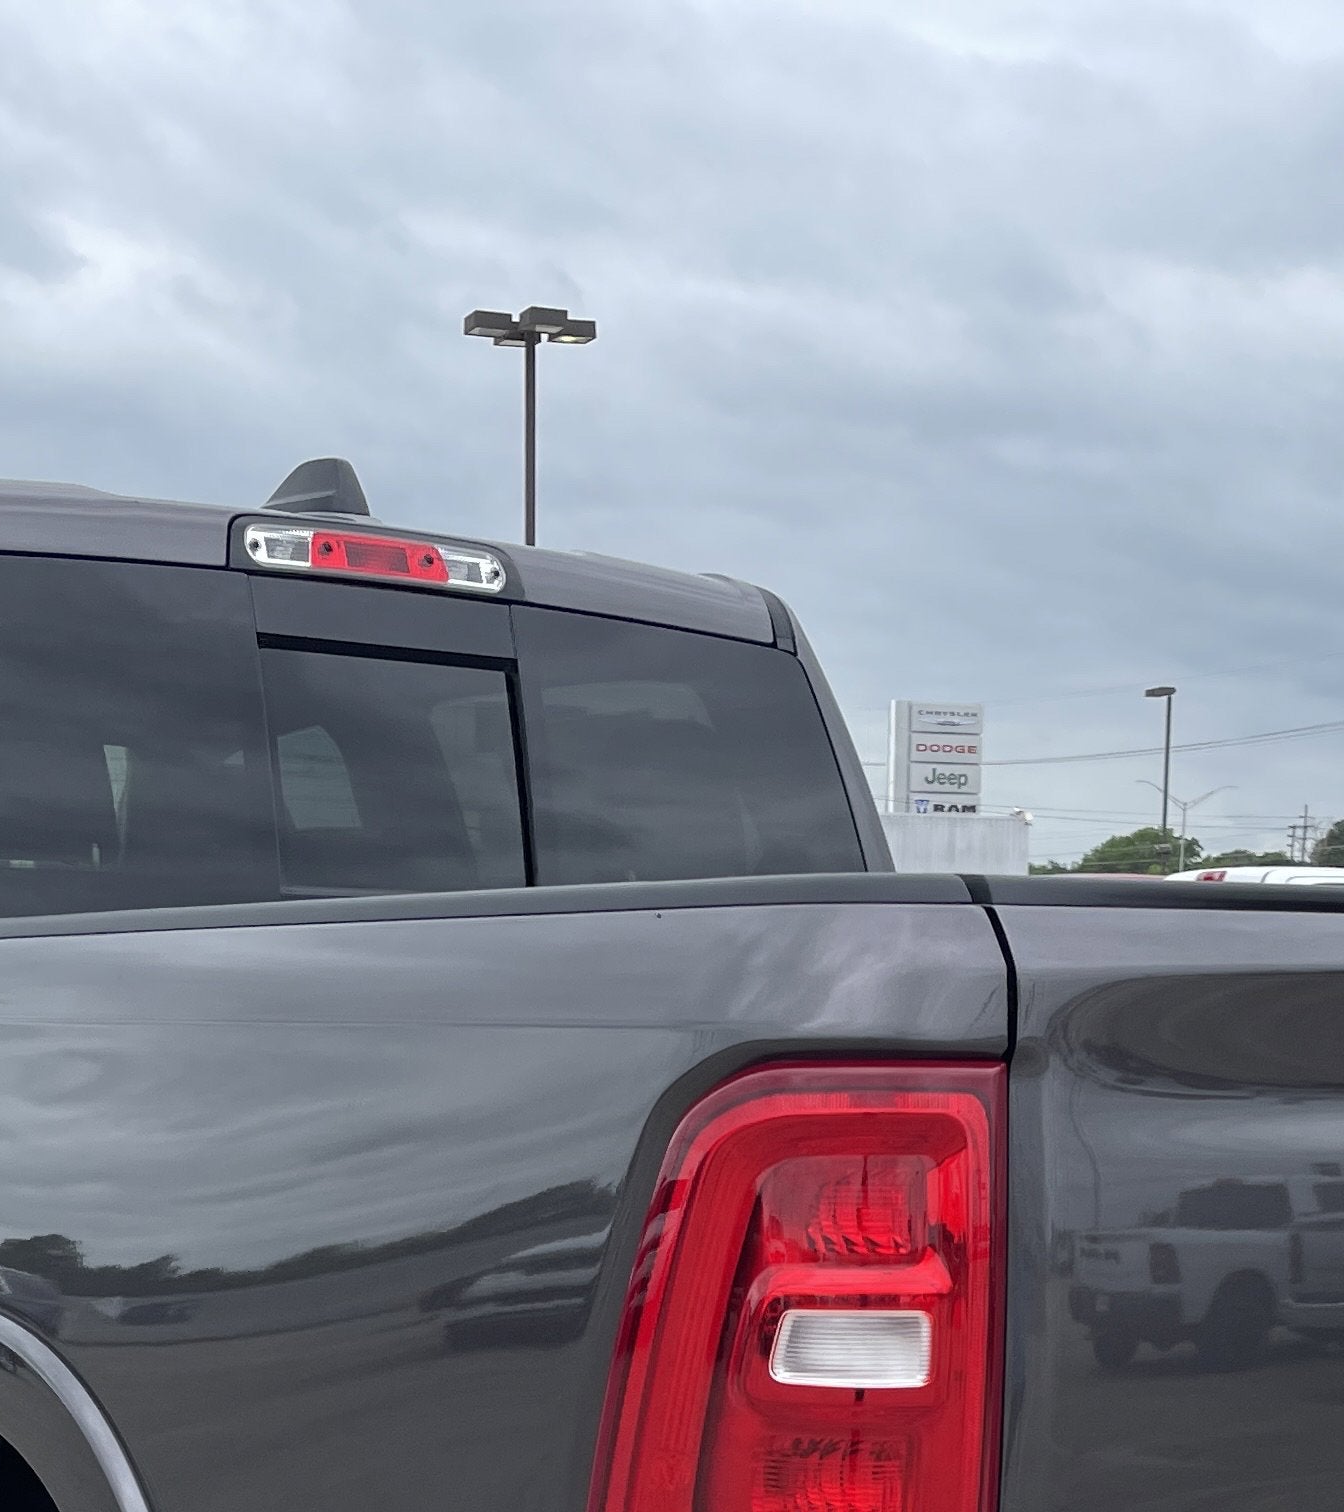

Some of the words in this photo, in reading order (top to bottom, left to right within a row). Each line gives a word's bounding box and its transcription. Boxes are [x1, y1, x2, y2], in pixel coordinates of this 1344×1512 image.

[917, 709, 978, 718] CHRYSLER
[916, 743, 977, 754] DODGE
[924, 768, 968, 789] Jeep
